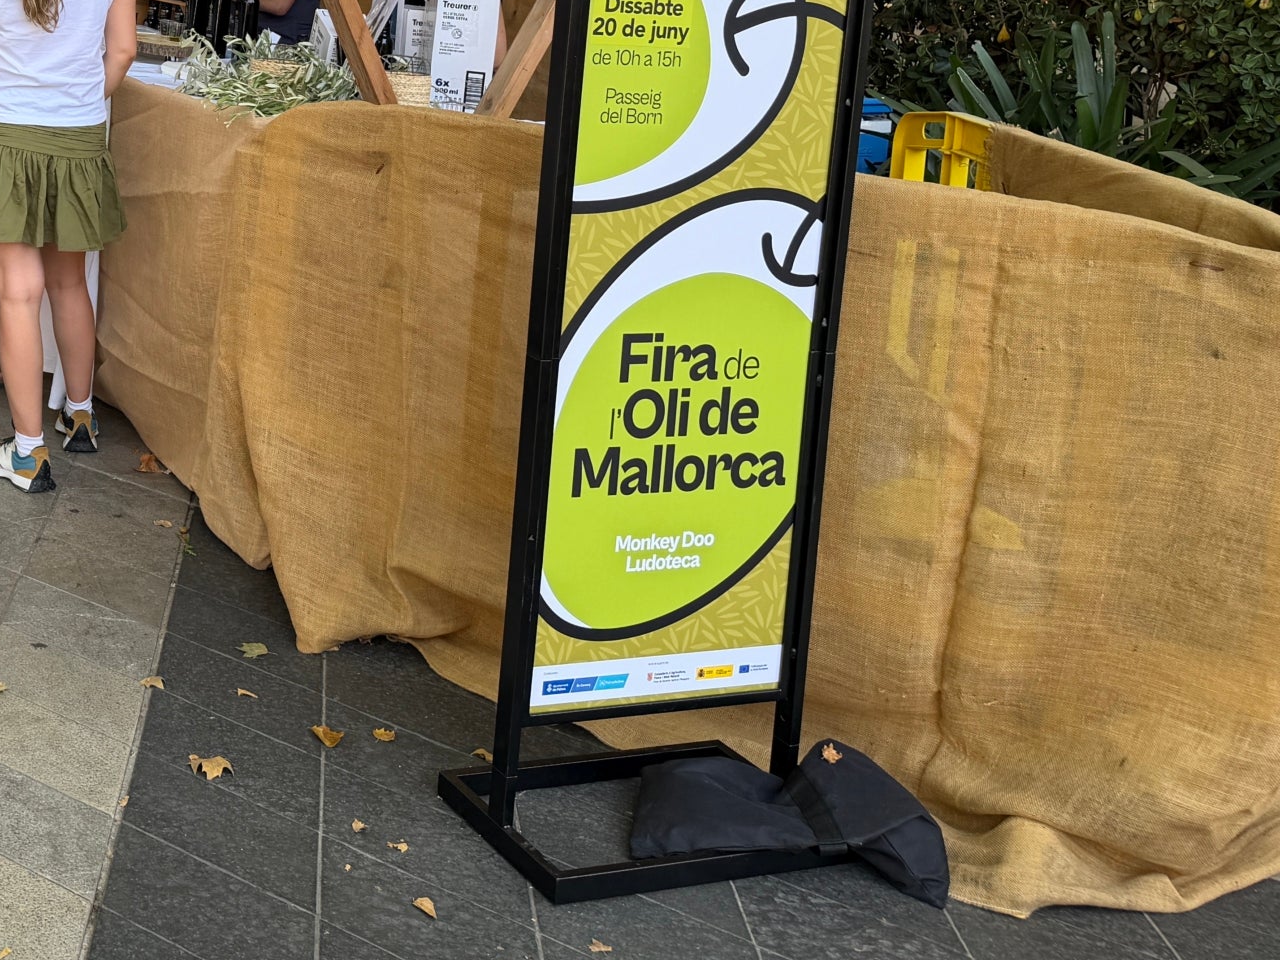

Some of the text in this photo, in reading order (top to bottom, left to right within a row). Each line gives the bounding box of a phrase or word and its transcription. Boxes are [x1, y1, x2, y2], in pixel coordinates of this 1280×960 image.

[592, 17, 690, 46] 20 de juny
[592, 49, 682, 68] de 10h a 15h
[435, 77, 450, 88] 6x
[604, 88, 662, 109] Passeig
[600, 107, 663, 125] del Born
[619, 332, 761, 384] Fira de
[609, 386, 760, 440] l'Oli de
[571, 444, 786, 499] Mallorca
[614, 530, 715, 554] Monkey Doo
[625, 553, 701, 574] Ludoteca
